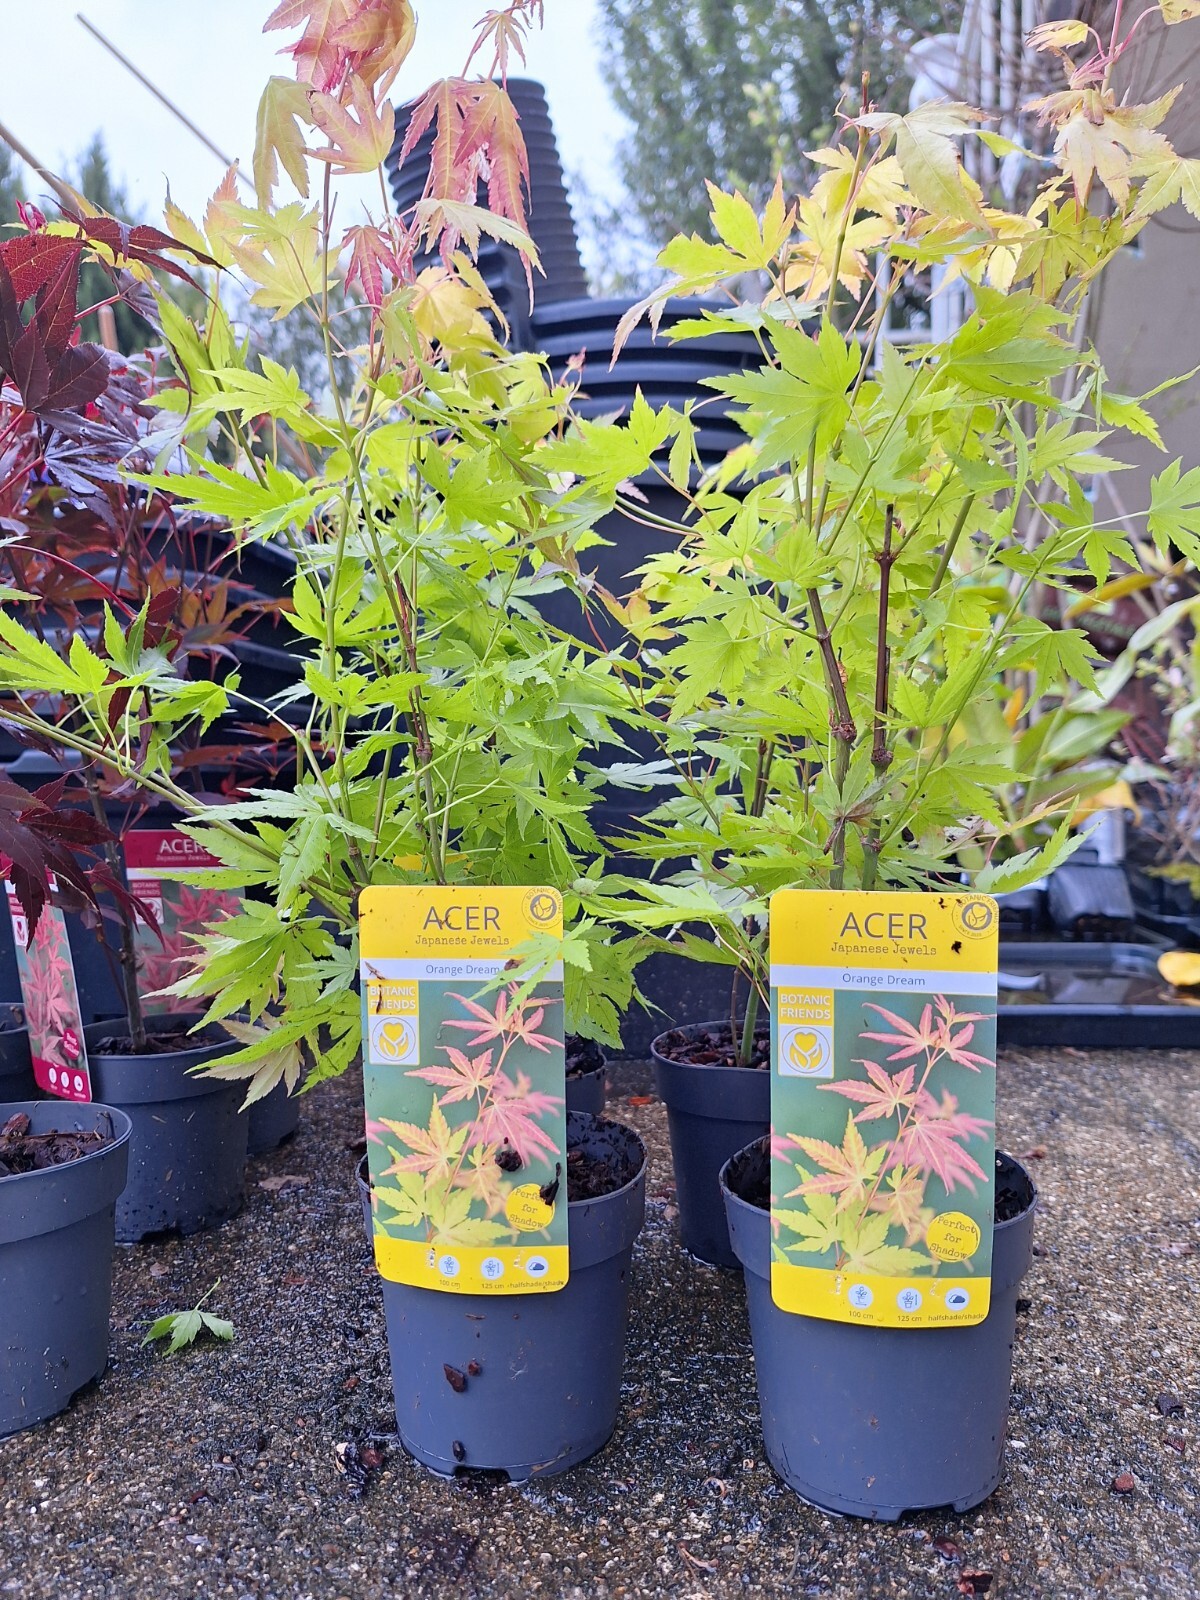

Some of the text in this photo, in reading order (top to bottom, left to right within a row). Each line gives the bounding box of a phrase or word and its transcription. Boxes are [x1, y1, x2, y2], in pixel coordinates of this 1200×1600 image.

[422, 905, 502, 931] ACER
[839, 911, 928, 940] ACER
[415, 934, 510, 948] Japanese Jewels
[831, 941, 937, 956] Japanese Jewels
[425, 964, 500, 976] Orange Dream
[842, 973, 926, 986] Orange Dream
[369, 986, 416, 997] BOTANIC
[780, 994, 831, 1006] BOTANIC
[780, 1007, 831, 1020] FRIENDS
[521, 1203, 538, 1214] for
[509, 1213, 544, 1228] Shadow
[937, 1215, 976, 1234] Perfect
[944, 1232, 962, 1243] for
[929, 1242, 968, 1259] Shadow
[849, 1310, 861, 1318] 100
[927, 1313, 985, 1322] halfshade/shade
